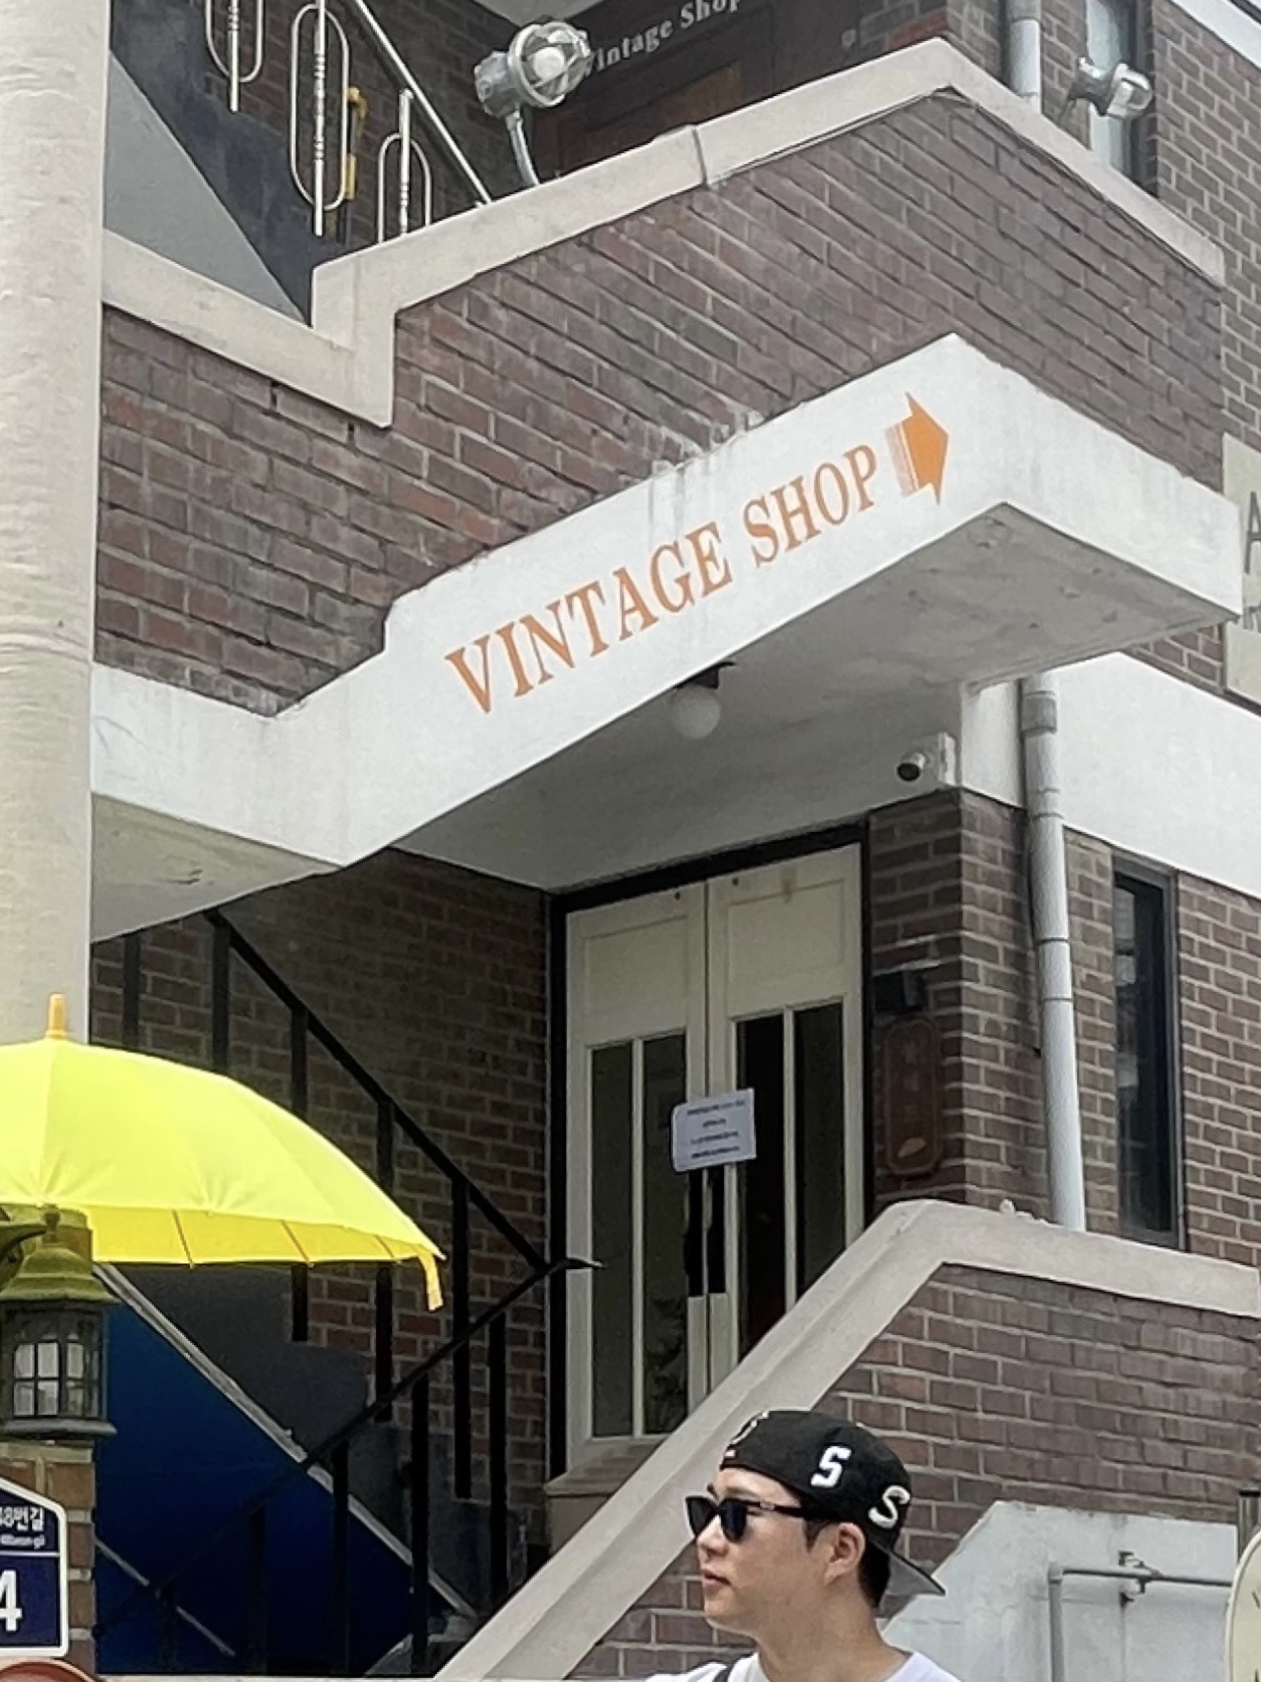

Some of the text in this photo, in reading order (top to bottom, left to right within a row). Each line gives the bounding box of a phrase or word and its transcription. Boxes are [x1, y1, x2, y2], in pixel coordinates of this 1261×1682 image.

[445, 443, 878, 715] VINTAGE SHOP
[810, 1445, 852, 1488] S
[868, 1485, 911, 1529] S
